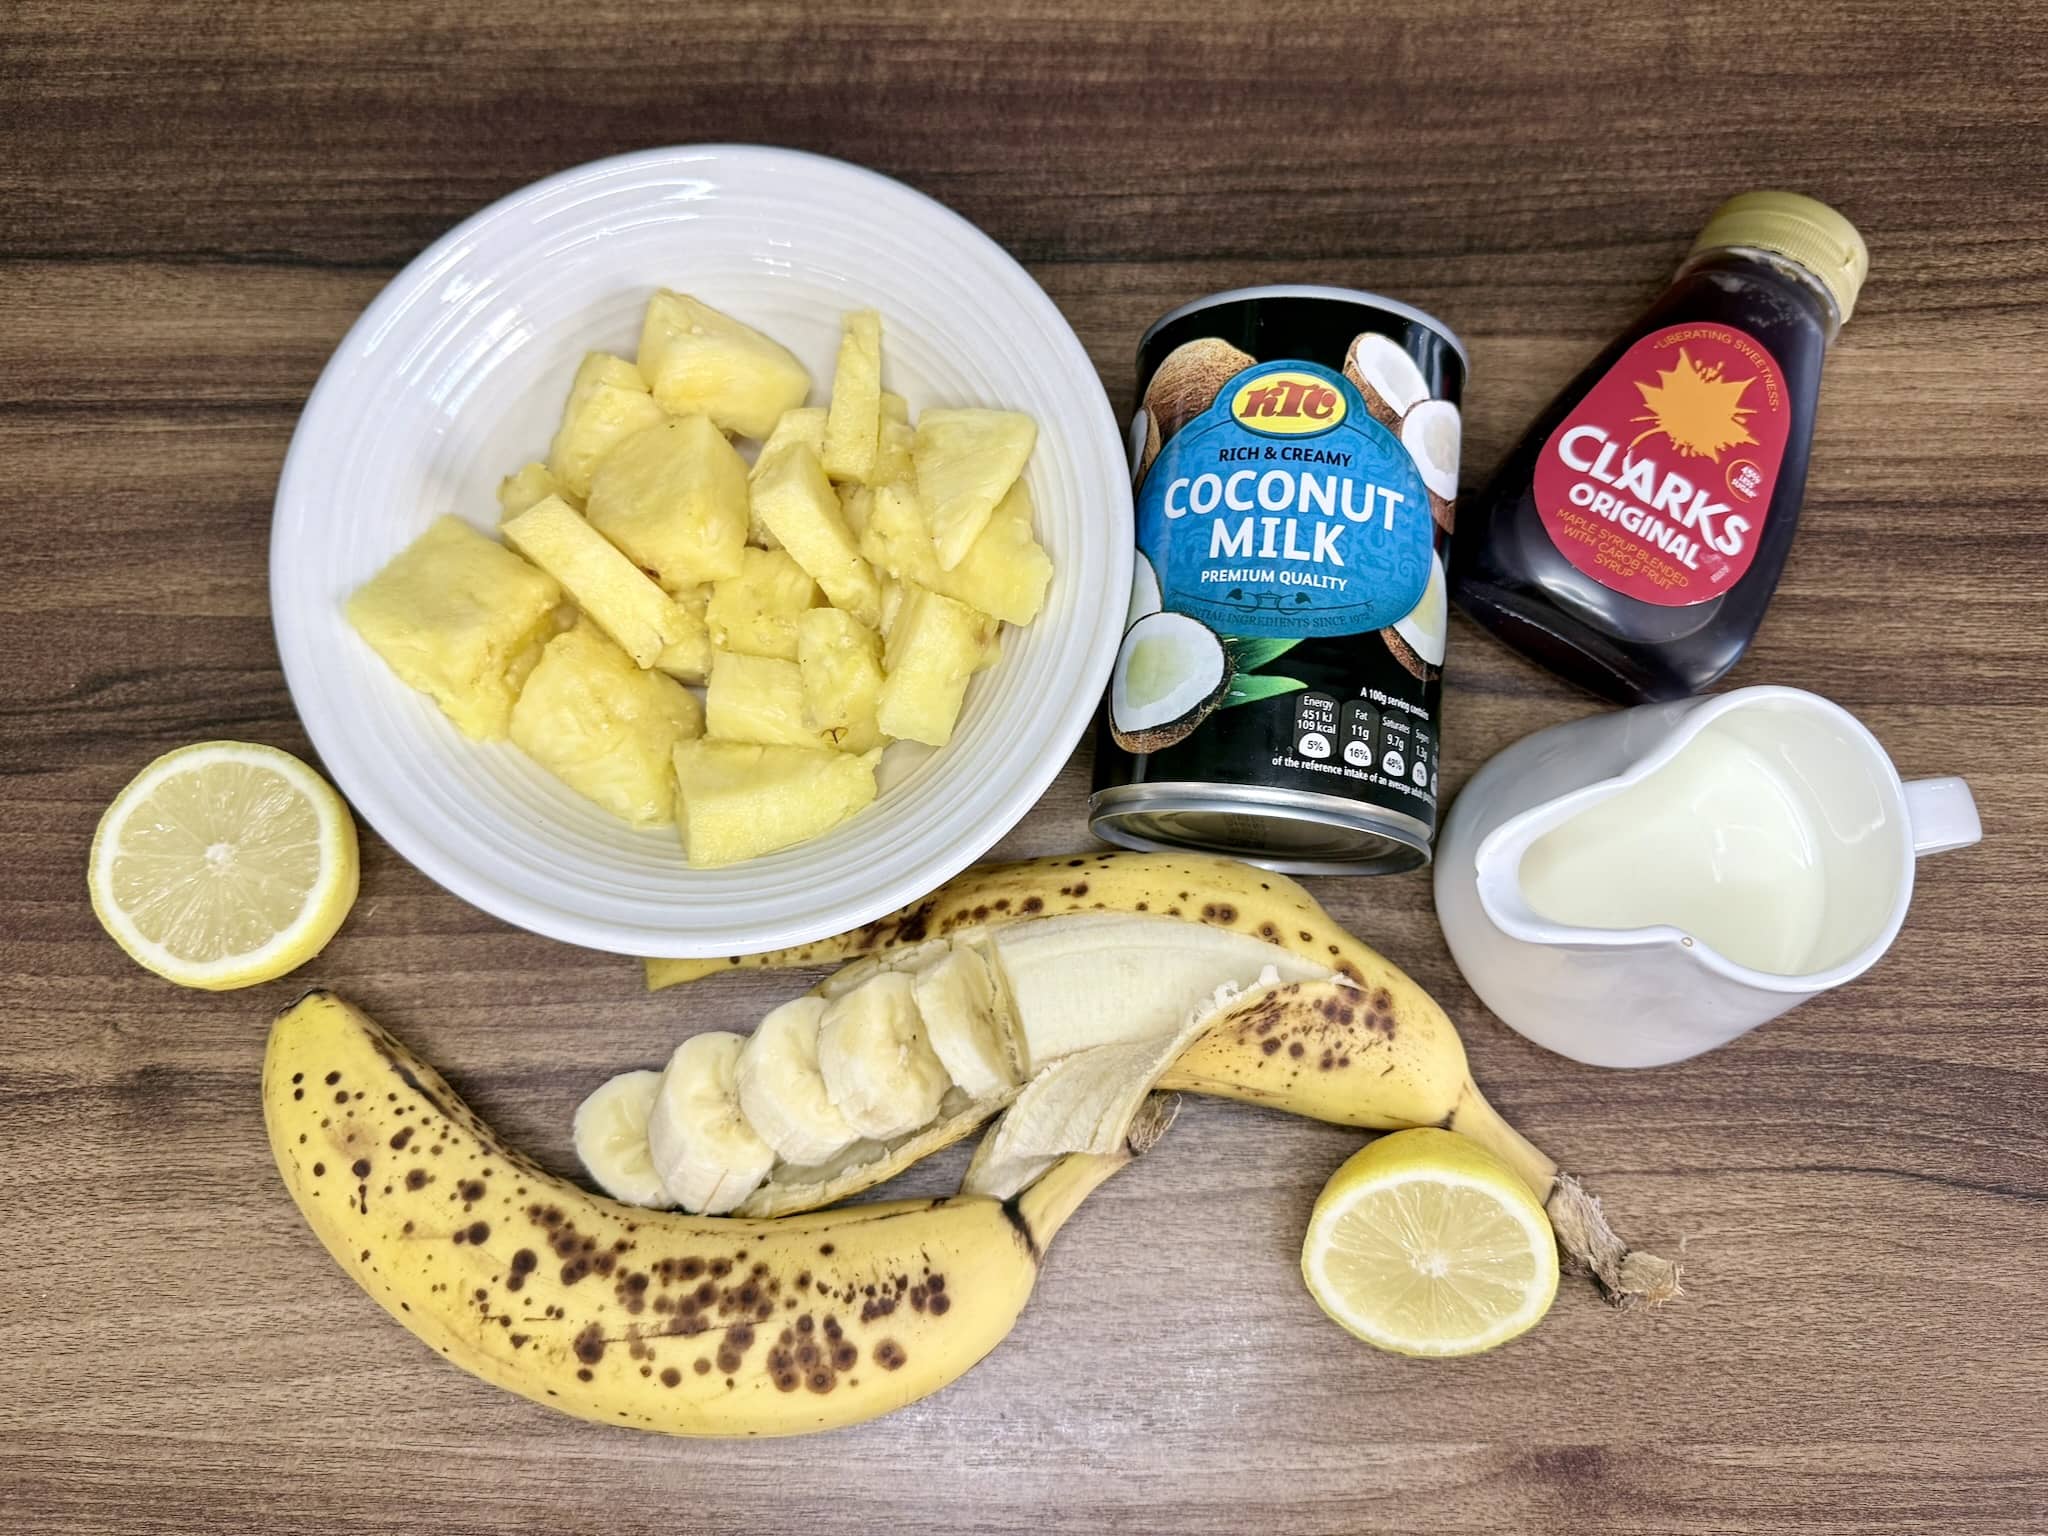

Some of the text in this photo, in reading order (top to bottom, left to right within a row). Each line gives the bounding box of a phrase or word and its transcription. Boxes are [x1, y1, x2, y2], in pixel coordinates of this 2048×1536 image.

[1658, 329, 1778, 405] LIBERATING SWEETNESS
[1219, 446, 1352, 467] RICH & CREAMY
[1164, 470, 1405, 531] COCONUT
[1558, 425, 1750, 557] CLARKS
[1569, 483, 1700, 571] ORIGINAL
[1209, 517, 1346, 566] MILK
[1556, 509, 1598, 533] MAPLE
[1599, 528, 1637, 553] SYRUP
[1637, 549, 1689, 587] BLENDED
[1564, 525, 1676, 590] WITH CAROB FRUIT
[1594, 553, 1634, 577] SYRUP
[1201, 570, 1348, 591] PREMIUM QUALITY
[1228, 613, 1310, 627] INGREDIENTS
[1312, 615, 1348, 627] SINCE
[1303, 695, 1334, 711] Energy
[1360, 687, 1367, 697] A
[1369, 689, 1387, 705] 100g
[1387, 698, 1410, 713] serving
[1302, 709, 1320, 721] 451
[1355, 709, 1368, 720] Fat
[1297, 719, 1336, 734] 109 kcal
[1351, 724, 1370, 740] 11g
[1307, 740, 1324, 751] 5%
[1387, 734, 1404, 751] 9.7g
[1349, 748, 1369, 761] 16%
[1272, 756, 1283, 766] of
[1284, 757, 1300, 769] the
[1301, 760, 1343, 776] reference
[1344, 766, 1368, 781] intake
[1369, 773, 1378, 783] of
[1379, 776, 1388, 786] an
